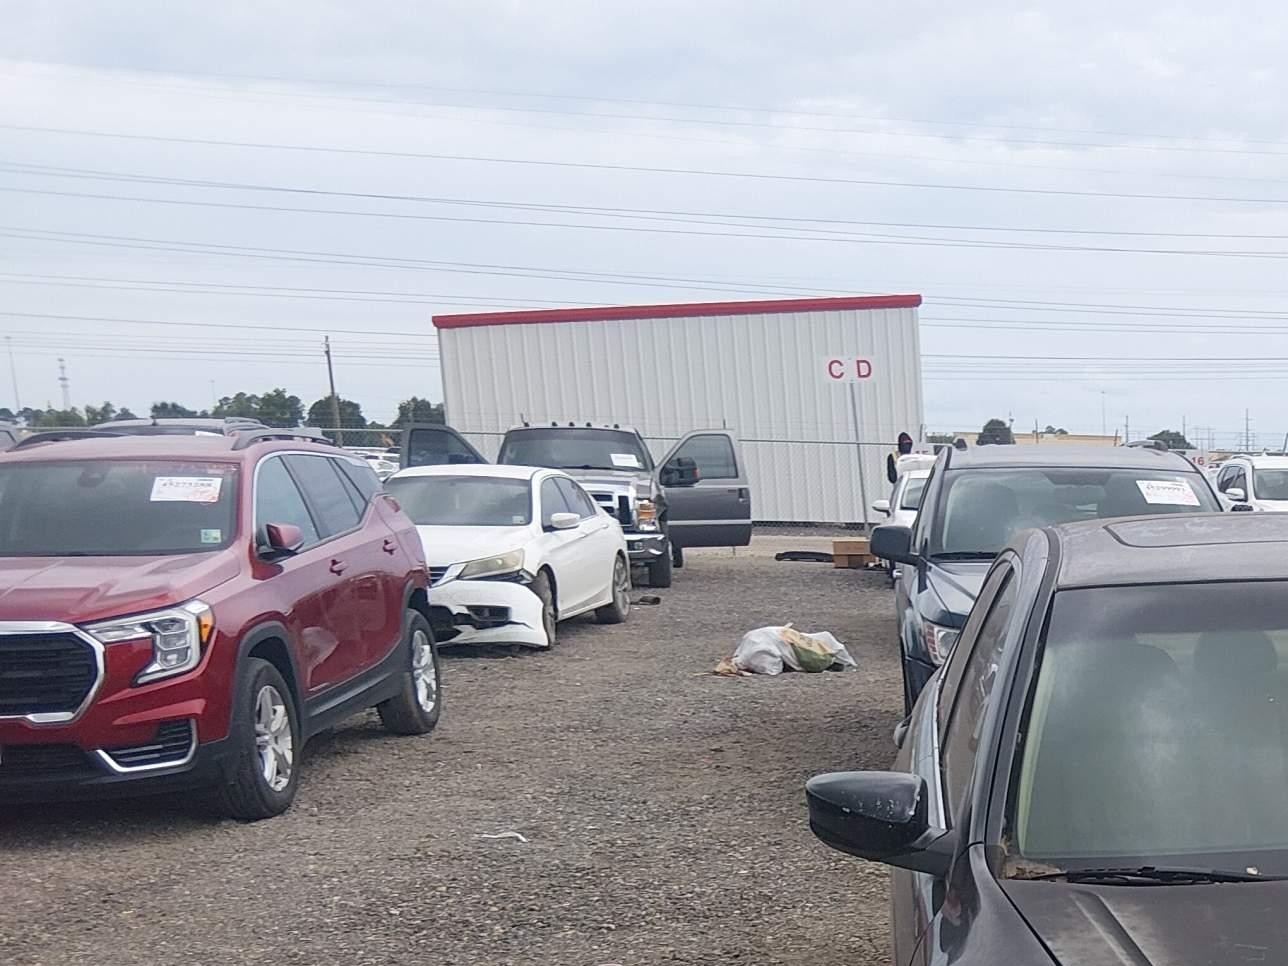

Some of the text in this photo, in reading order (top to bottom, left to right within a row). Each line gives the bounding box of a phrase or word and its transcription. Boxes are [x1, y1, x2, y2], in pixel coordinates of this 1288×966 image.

[828, 359, 872, 380] C D
[1191, 456, 1205, 466] 16
